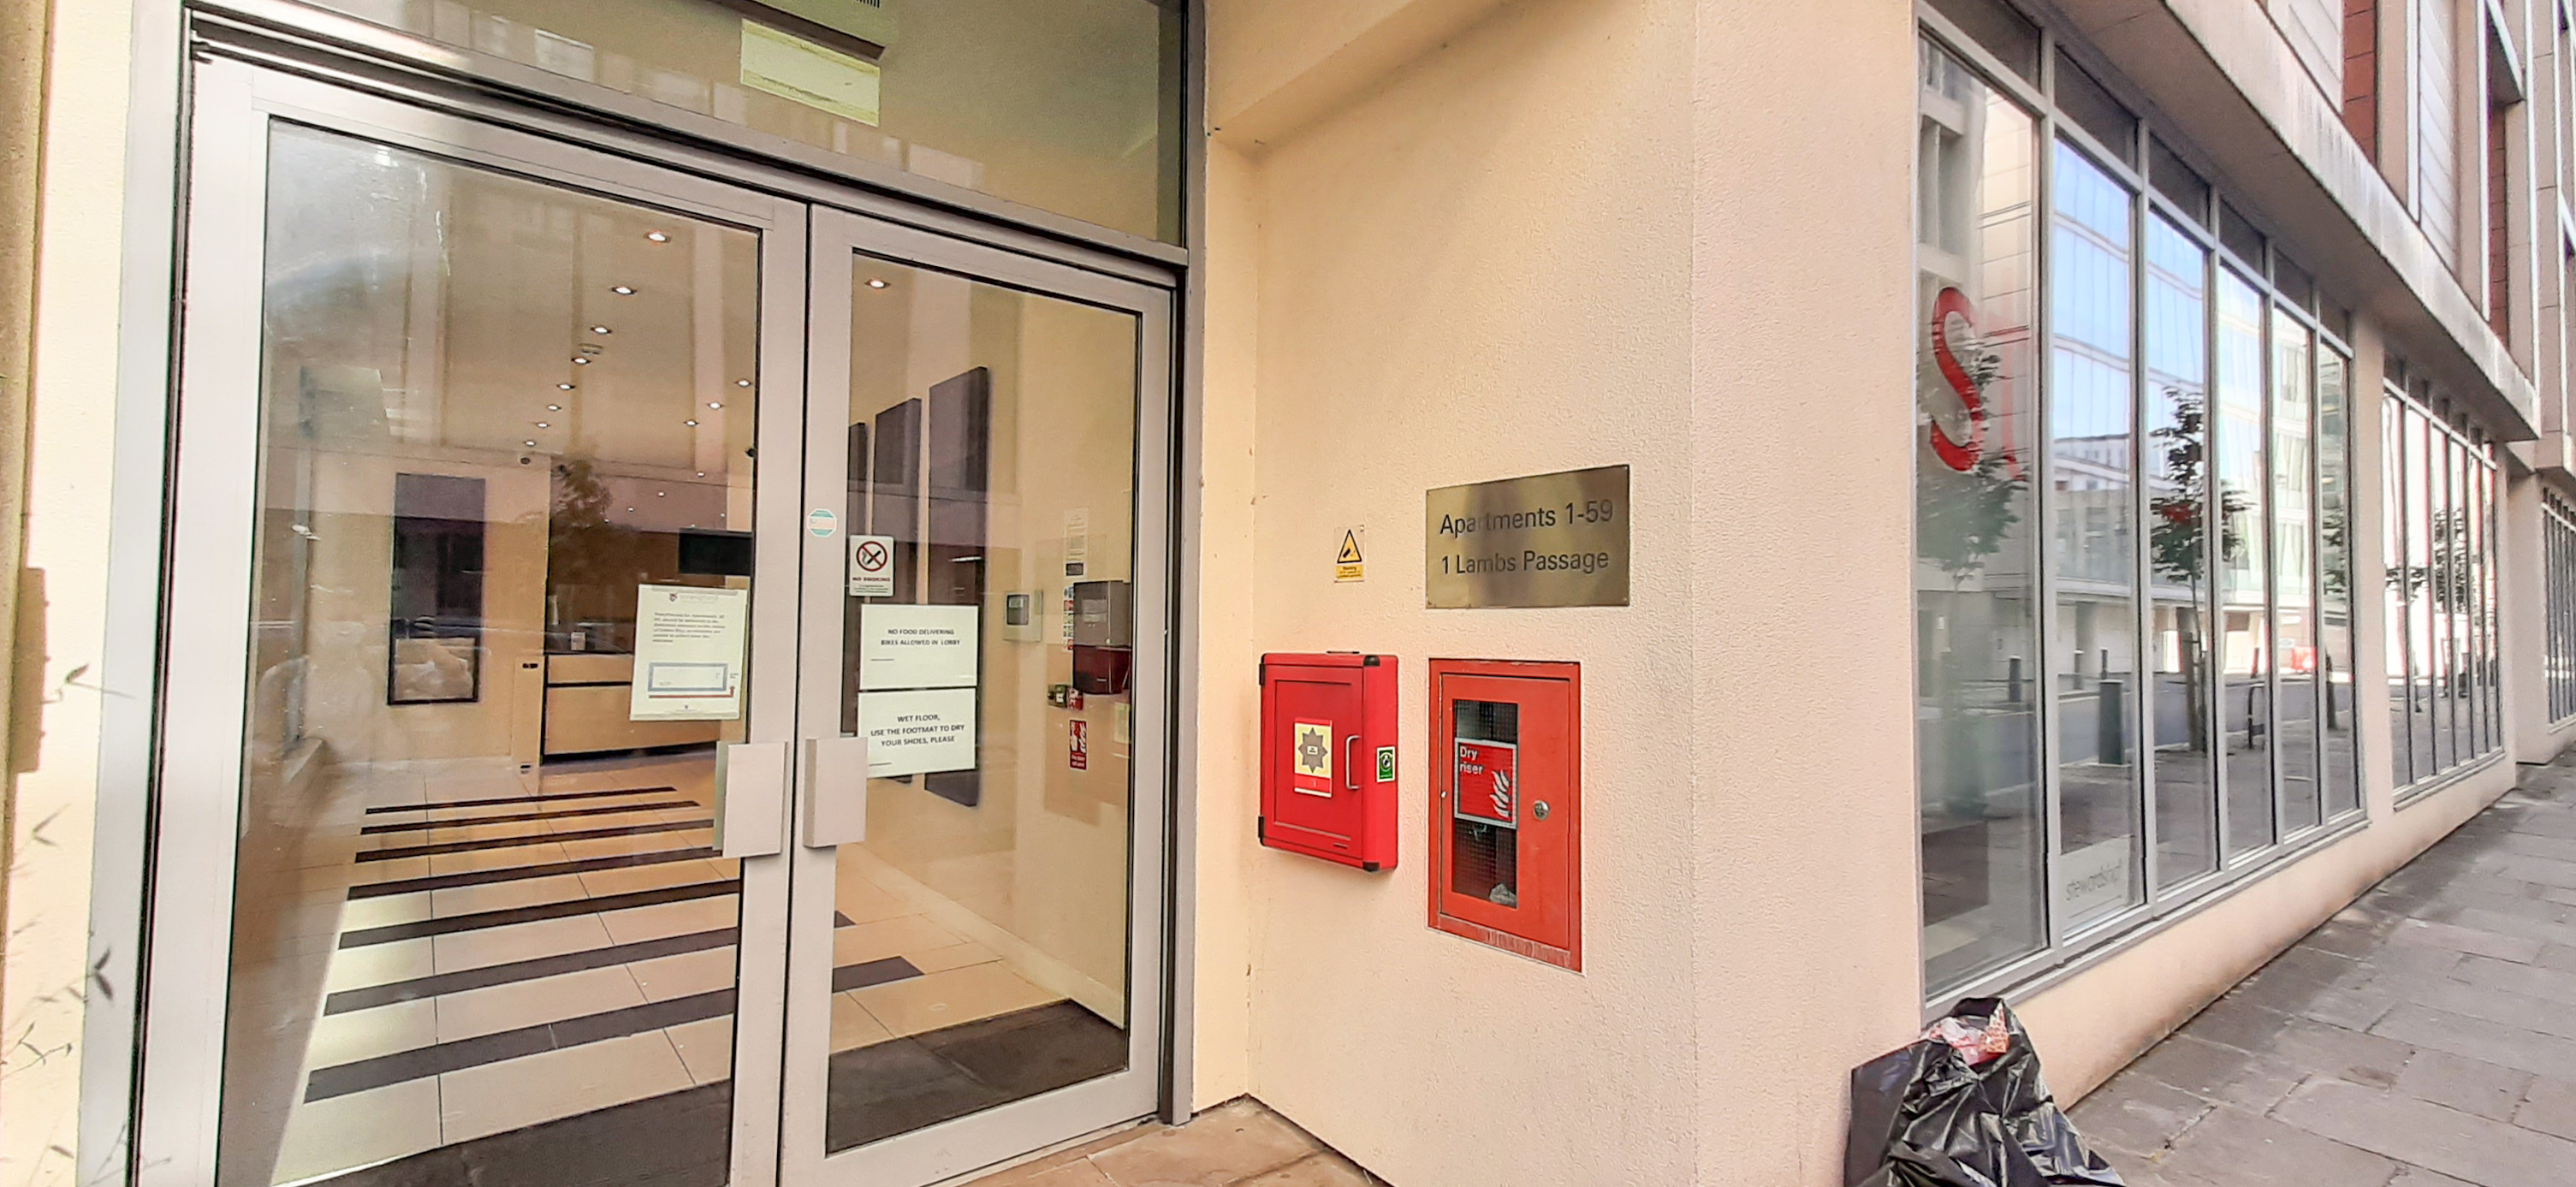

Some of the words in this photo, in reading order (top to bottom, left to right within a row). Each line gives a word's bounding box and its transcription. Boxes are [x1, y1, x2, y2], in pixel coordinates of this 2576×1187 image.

[1439, 507, 1556, 539] Apartments
[1565, 499, 1614, 525] 1-59
[1441, 555, 1449, 574] 1
[1456, 553, 1517, 574] Lambs
[1522, 549, 1610, 574] Passage
[903, 726, 937, 734] FOOTMAT
[1460, 746, 1478, 761] Dry
[1460, 762, 1483, 775] riser
